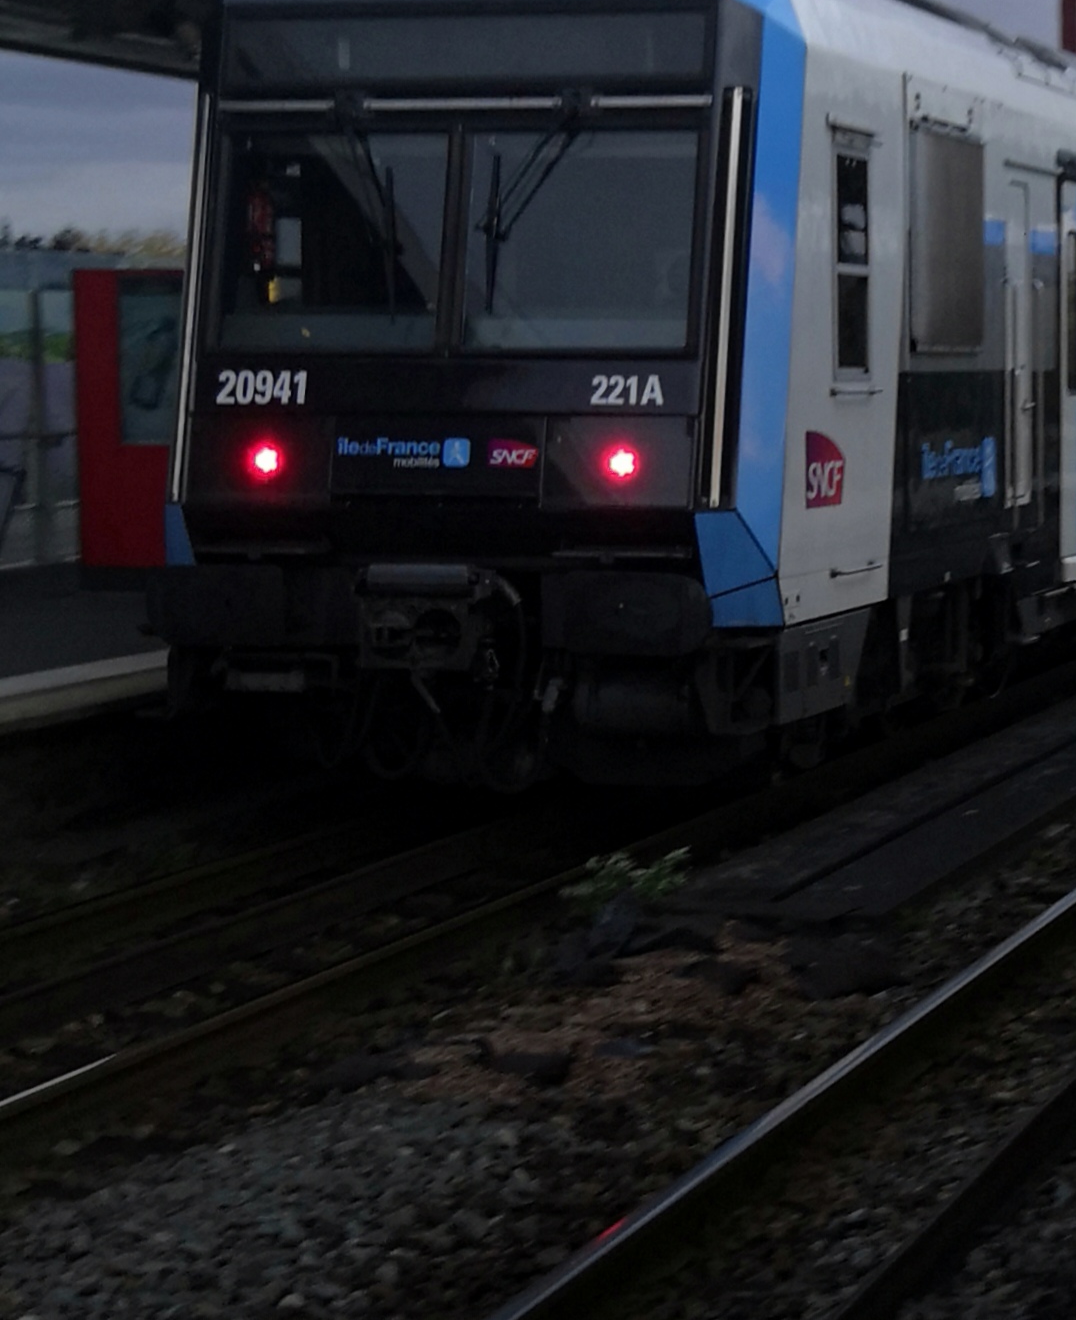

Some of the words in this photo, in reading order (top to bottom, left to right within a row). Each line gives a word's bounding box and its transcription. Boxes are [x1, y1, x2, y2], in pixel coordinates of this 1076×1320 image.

[215, 368, 308, 406] 20941
[590, 374, 664, 406] 221A
[489, 448, 538, 466] SNCF
[807, 459, 843, 501] SNCF
